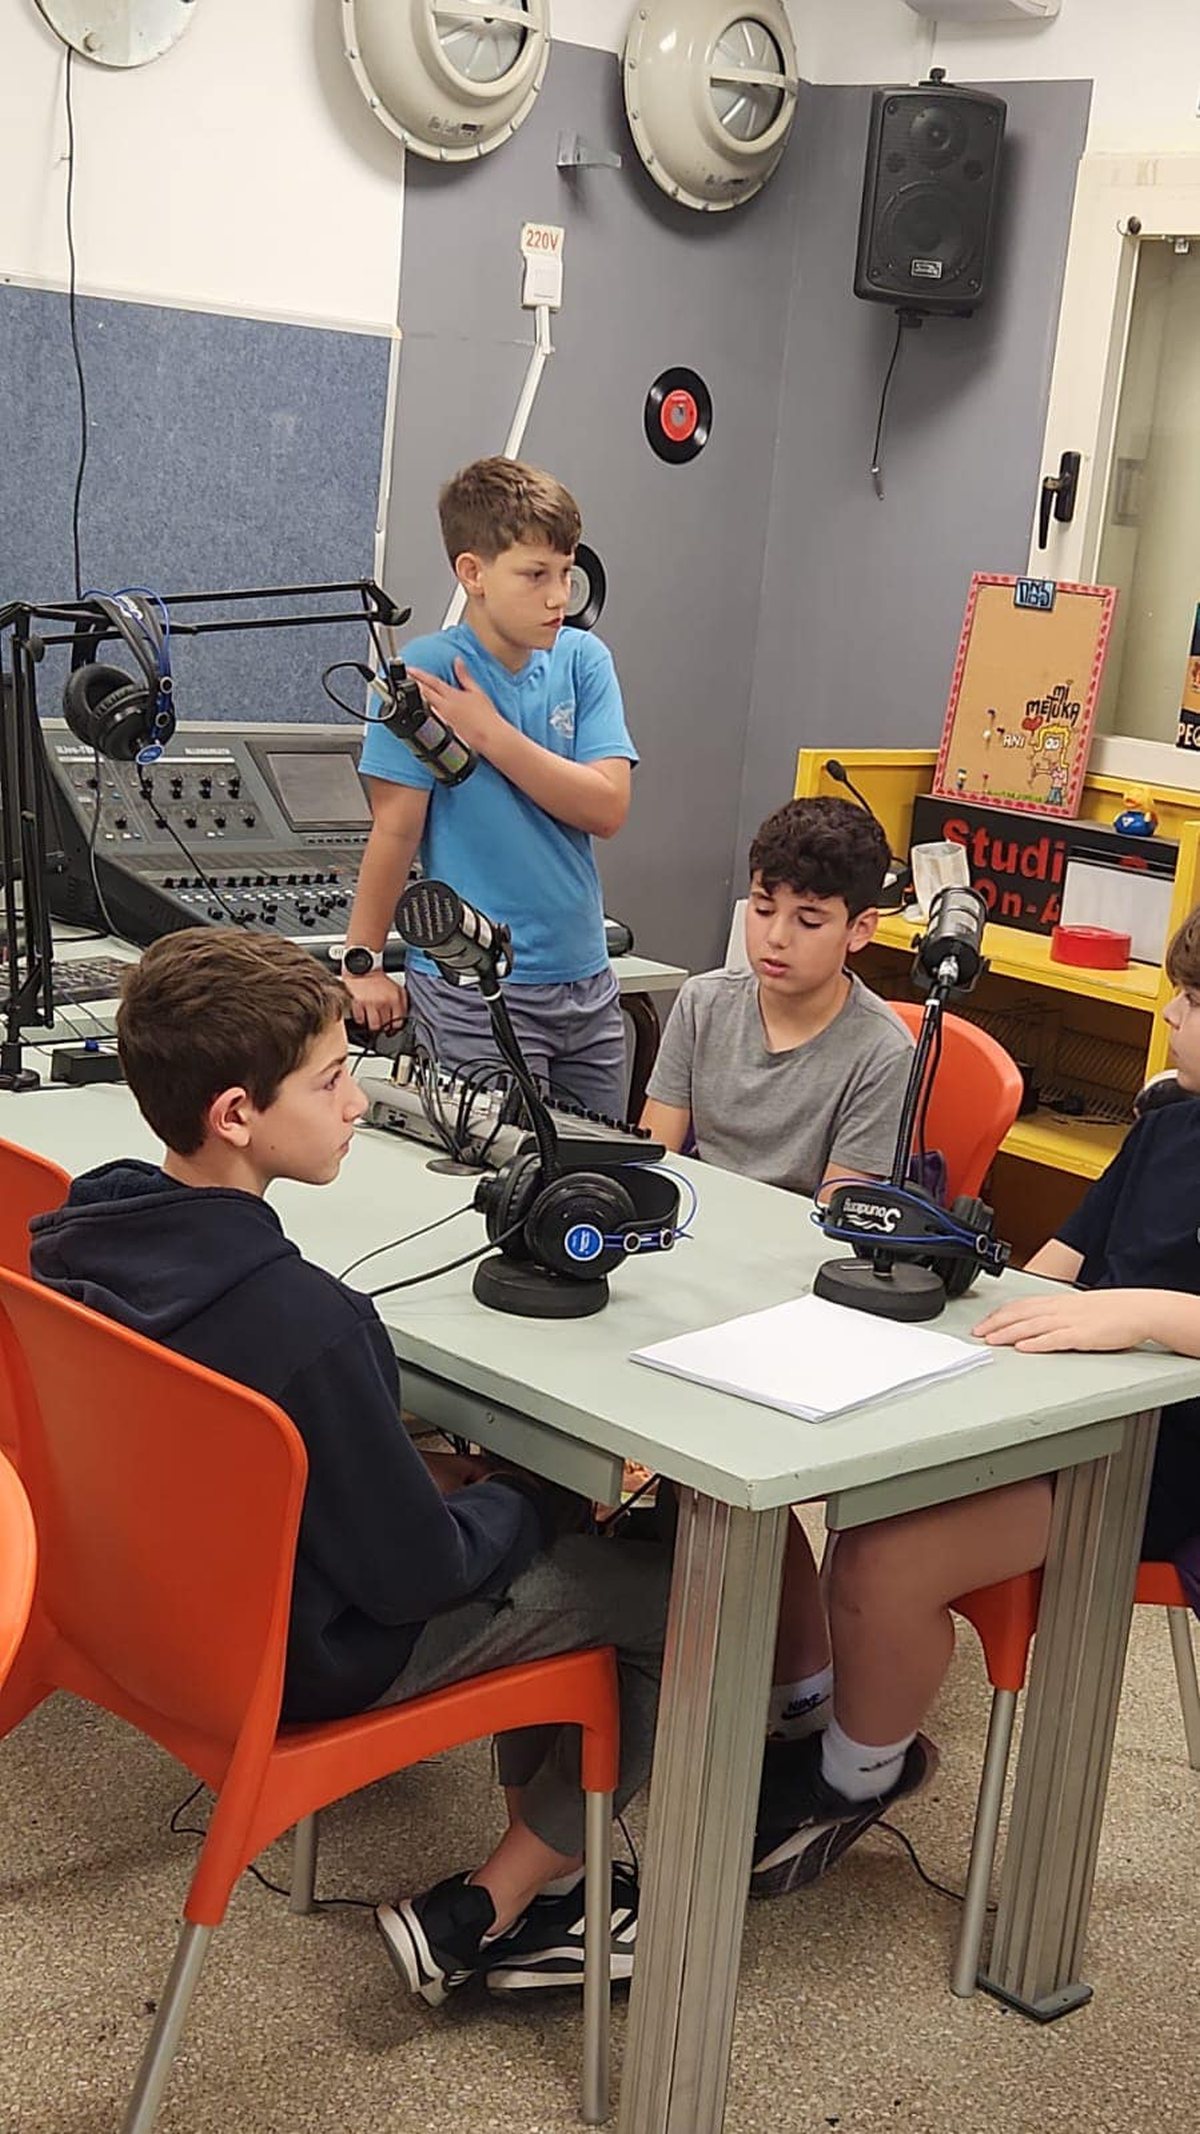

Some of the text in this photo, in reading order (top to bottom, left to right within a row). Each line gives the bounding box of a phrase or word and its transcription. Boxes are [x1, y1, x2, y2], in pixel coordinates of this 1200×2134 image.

[526, 229, 559, 252] 220V
[1003, 734, 1026, 749] ANI
[942, 818, 1066, 884] Studi
[973, 878, 1061, 925] On-A
